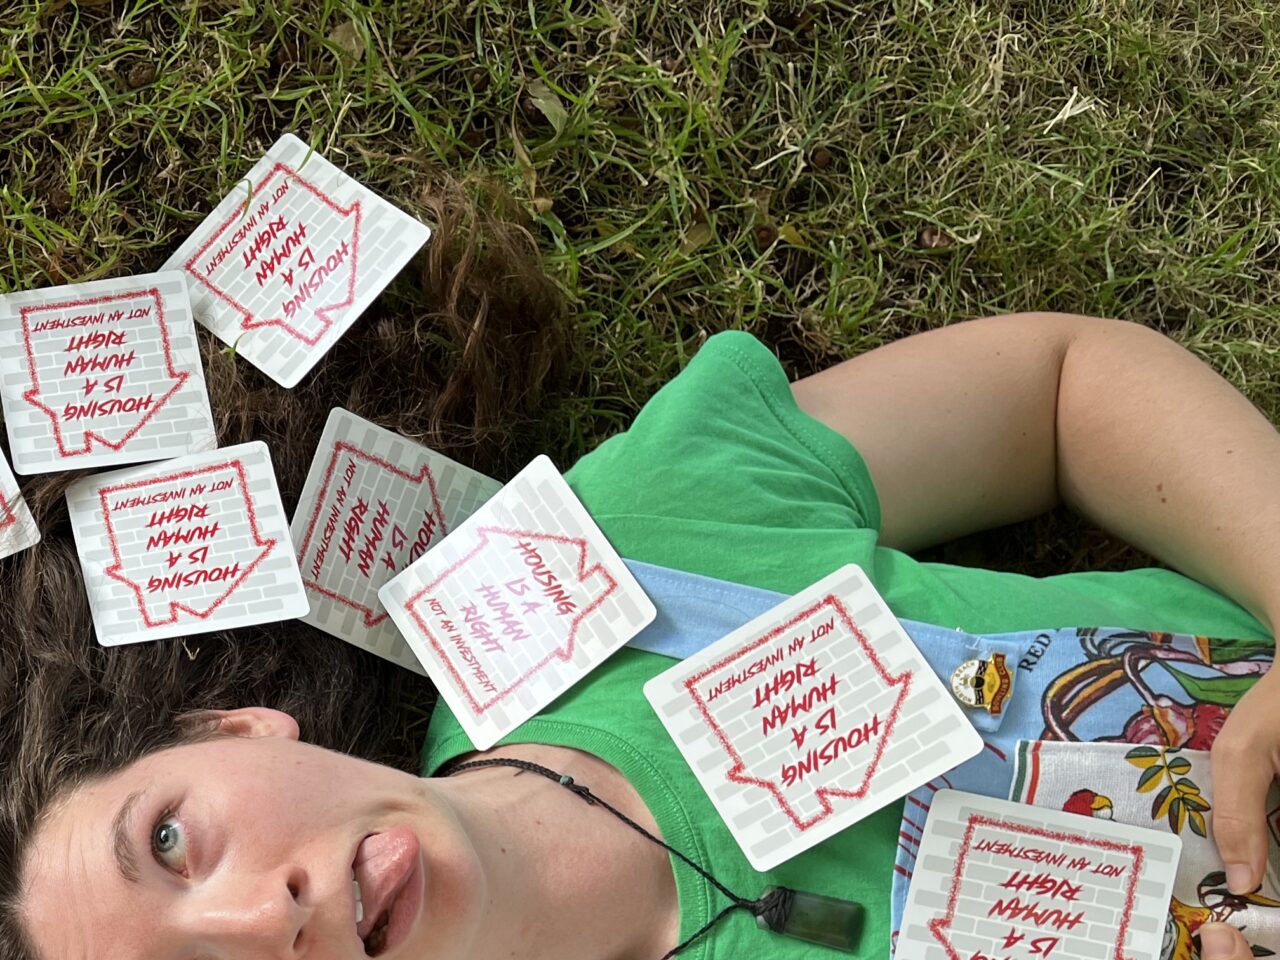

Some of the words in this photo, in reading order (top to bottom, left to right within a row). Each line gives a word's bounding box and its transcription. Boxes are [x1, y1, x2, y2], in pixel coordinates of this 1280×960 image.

[271, 180, 290, 204] NOT
[256, 200, 271, 219] AN
[204, 214, 258, 277] INVESTMENT
[241, 214, 288, 269] RIGHT
[254, 220, 307, 286] HUMAN
[296, 245, 316, 271] IS
[279, 266, 295, 287] A
[281, 240, 349, 318] HOUSING
[30, 311, 105, 333] INVESTMENT
[106, 309, 125, 322] AN
[126, 307, 152, 320] NOT
[63, 329, 126, 353] RIGHT
[62, 349, 135, 376] HUMAN
[82, 377, 99, 396] A
[102, 373, 125, 393] IS
[62, 393, 154, 422] HOUSING
[188, 483, 207, 496] AN
[208, 479, 235, 493] NOT
[110, 487, 187, 512] INVESTMENT
[145, 502, 209, 528] RIGHT
[145, 520, 220, 550] HUMAN
[165, 550, 183, 569] A
[186, 544, 209, 564] IS
[146, 562, 241, 594] HOUSING
[512, 540, 577, 616] HOUSING
[809, 618, 836, 643] NOT
[786, 635, 806, 655] AN
[1018, 633, 1052, 673] RED
[706, 646, 785, 703] INVESTMENT
[751, 657, 820, 709] RIGHT
[760, 672, 839, 736] HUMAN
[813, 705, 838, 736] IS
[790, 724, 809, 749] A
[779, 714, 882, 787] HOUSING
[970, 839, 1067, 867] INVESTMENT
[1066, 855, 1091, 871] AN
[1090, 862, 1125, 878] NOT
[1000, 869, 1082, 902] RIGHT
[987, 895, 1085, 930] HUMAN
[1002, 926, 1027, 950] A
[1028, 935, 1060, 958] IS
